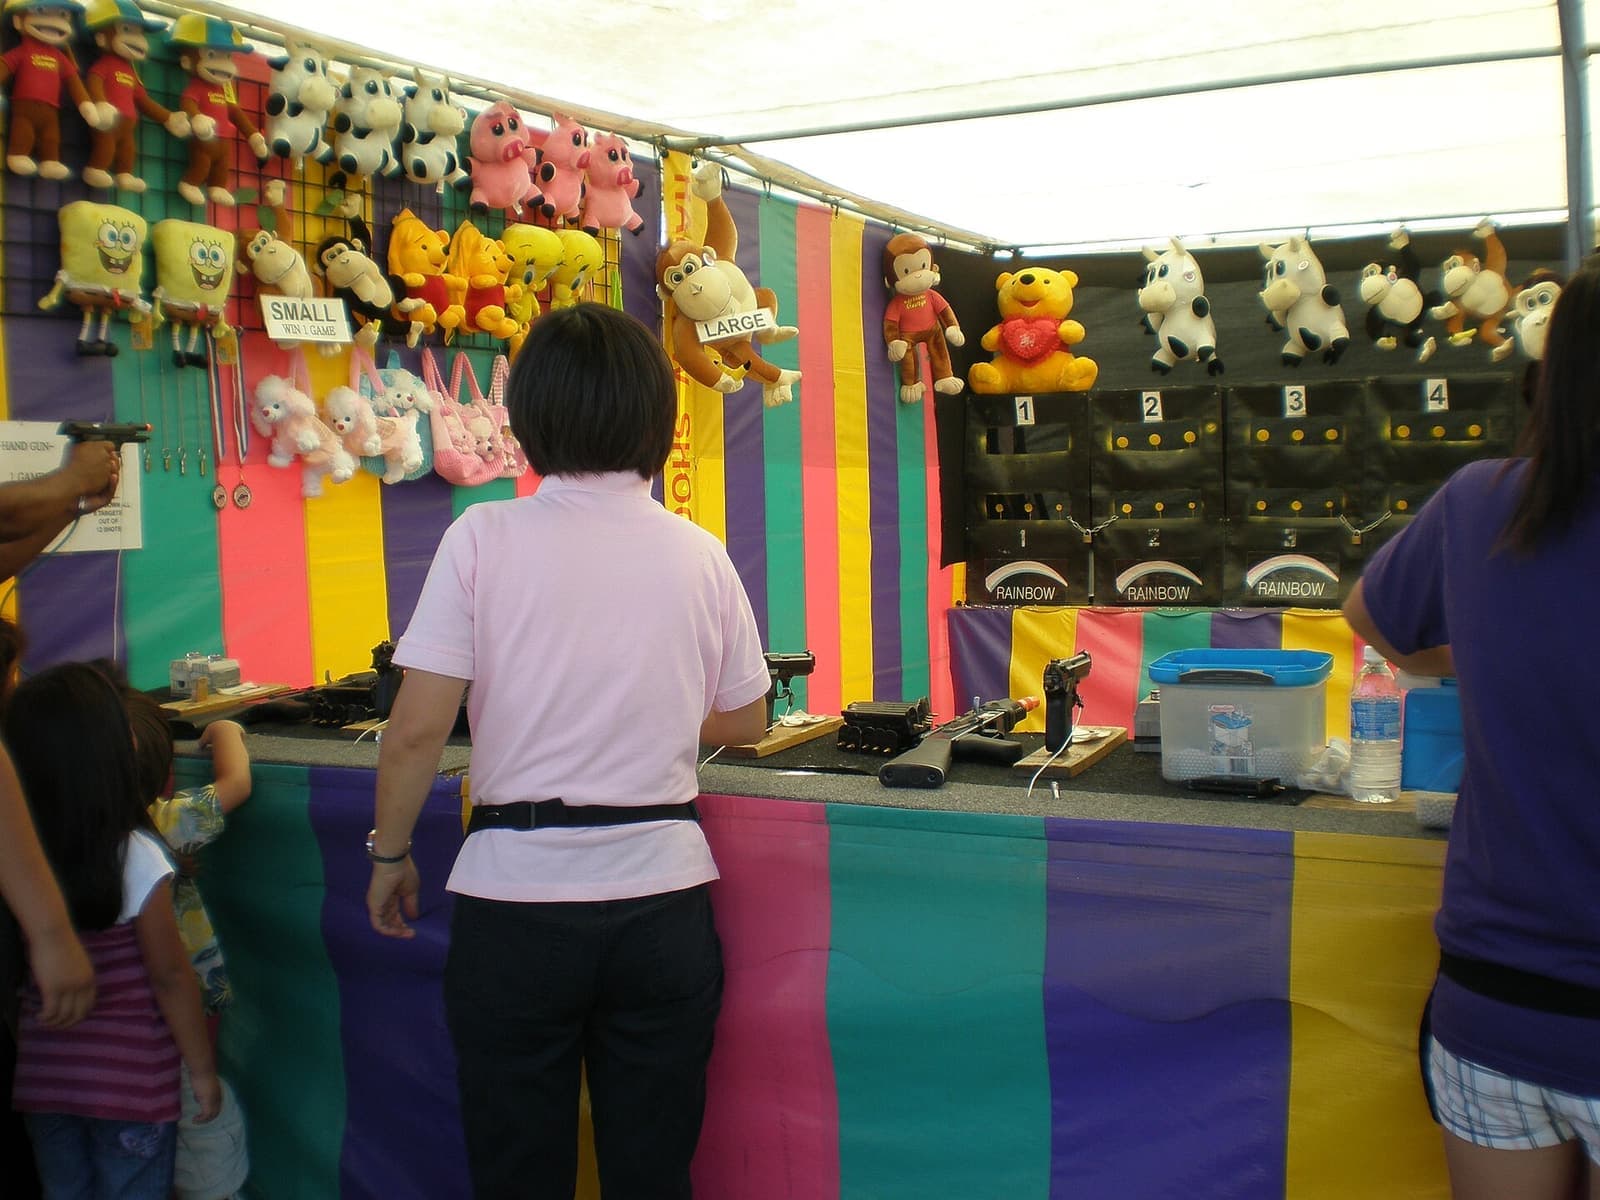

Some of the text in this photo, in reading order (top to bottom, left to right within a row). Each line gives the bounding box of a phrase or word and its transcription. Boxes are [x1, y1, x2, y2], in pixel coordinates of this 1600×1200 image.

[270, 301, 337, 322] SMALL
[281, 323, 337, 336] WIN 1 GAME
[703, 313, 767, 337] LARGE
[1288, 390, 1304, 411] 3
[1430, 383, 1446, 405] 4
[1018, 400, 1029, 421] 1
[1144, 396, 1159, 417] 2
[996, 586, 1056, 601] RAINBOW
[1127, 586, 1190, 601] RAINBOW
[1258, 581, 1325, 596] RAINBOW
